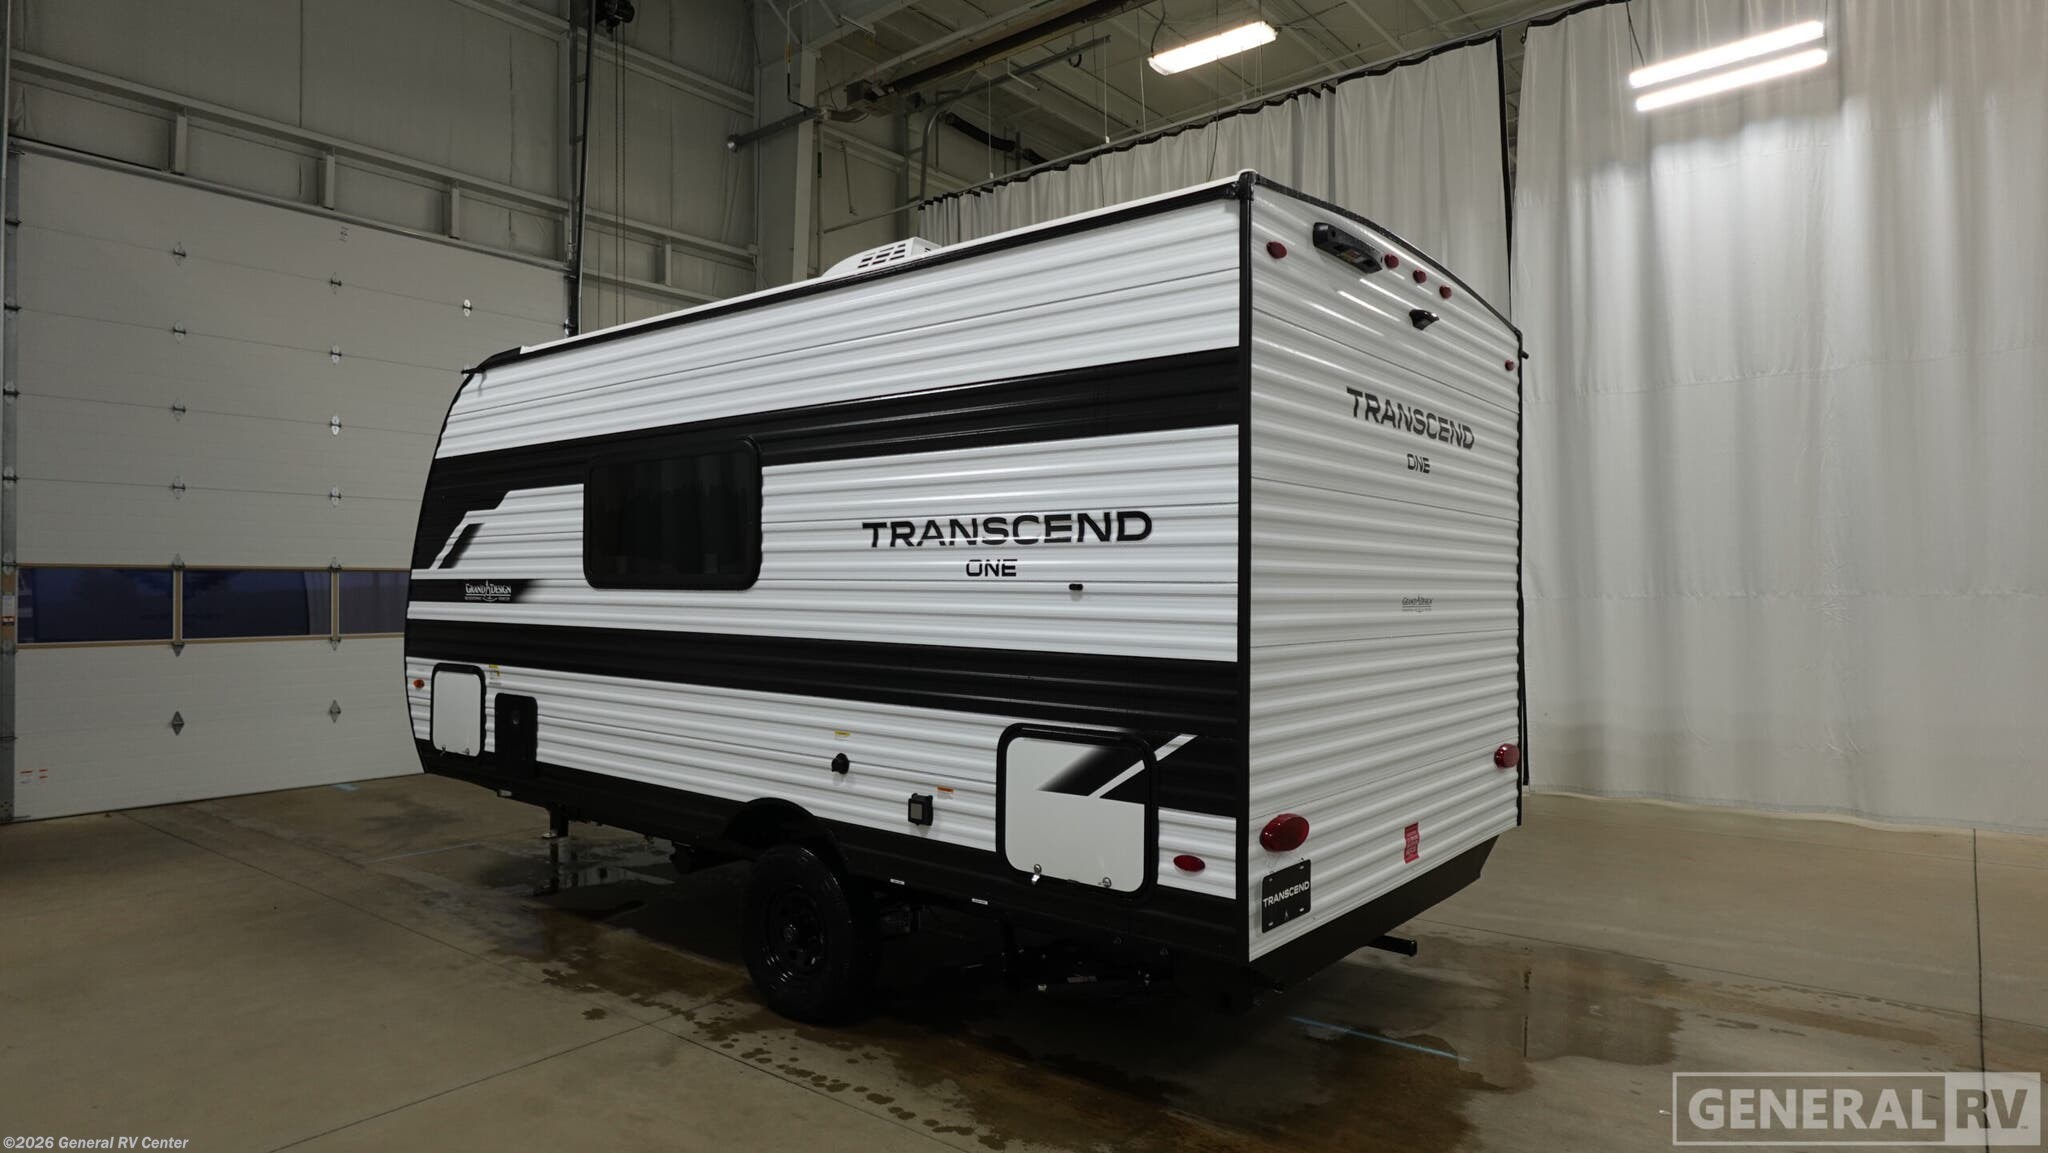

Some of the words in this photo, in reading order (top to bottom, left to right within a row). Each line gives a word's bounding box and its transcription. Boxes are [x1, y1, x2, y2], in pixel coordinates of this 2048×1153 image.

[1346, 387, 1475, 449] TRANSCEND
[1407, 453, 1430, 473] ONE
[862, 511, 1152, 547] TRANSCEND
[966, 558, 1017, 577] ONE
[1262, 881, 1310, 907] TRANSCEND
